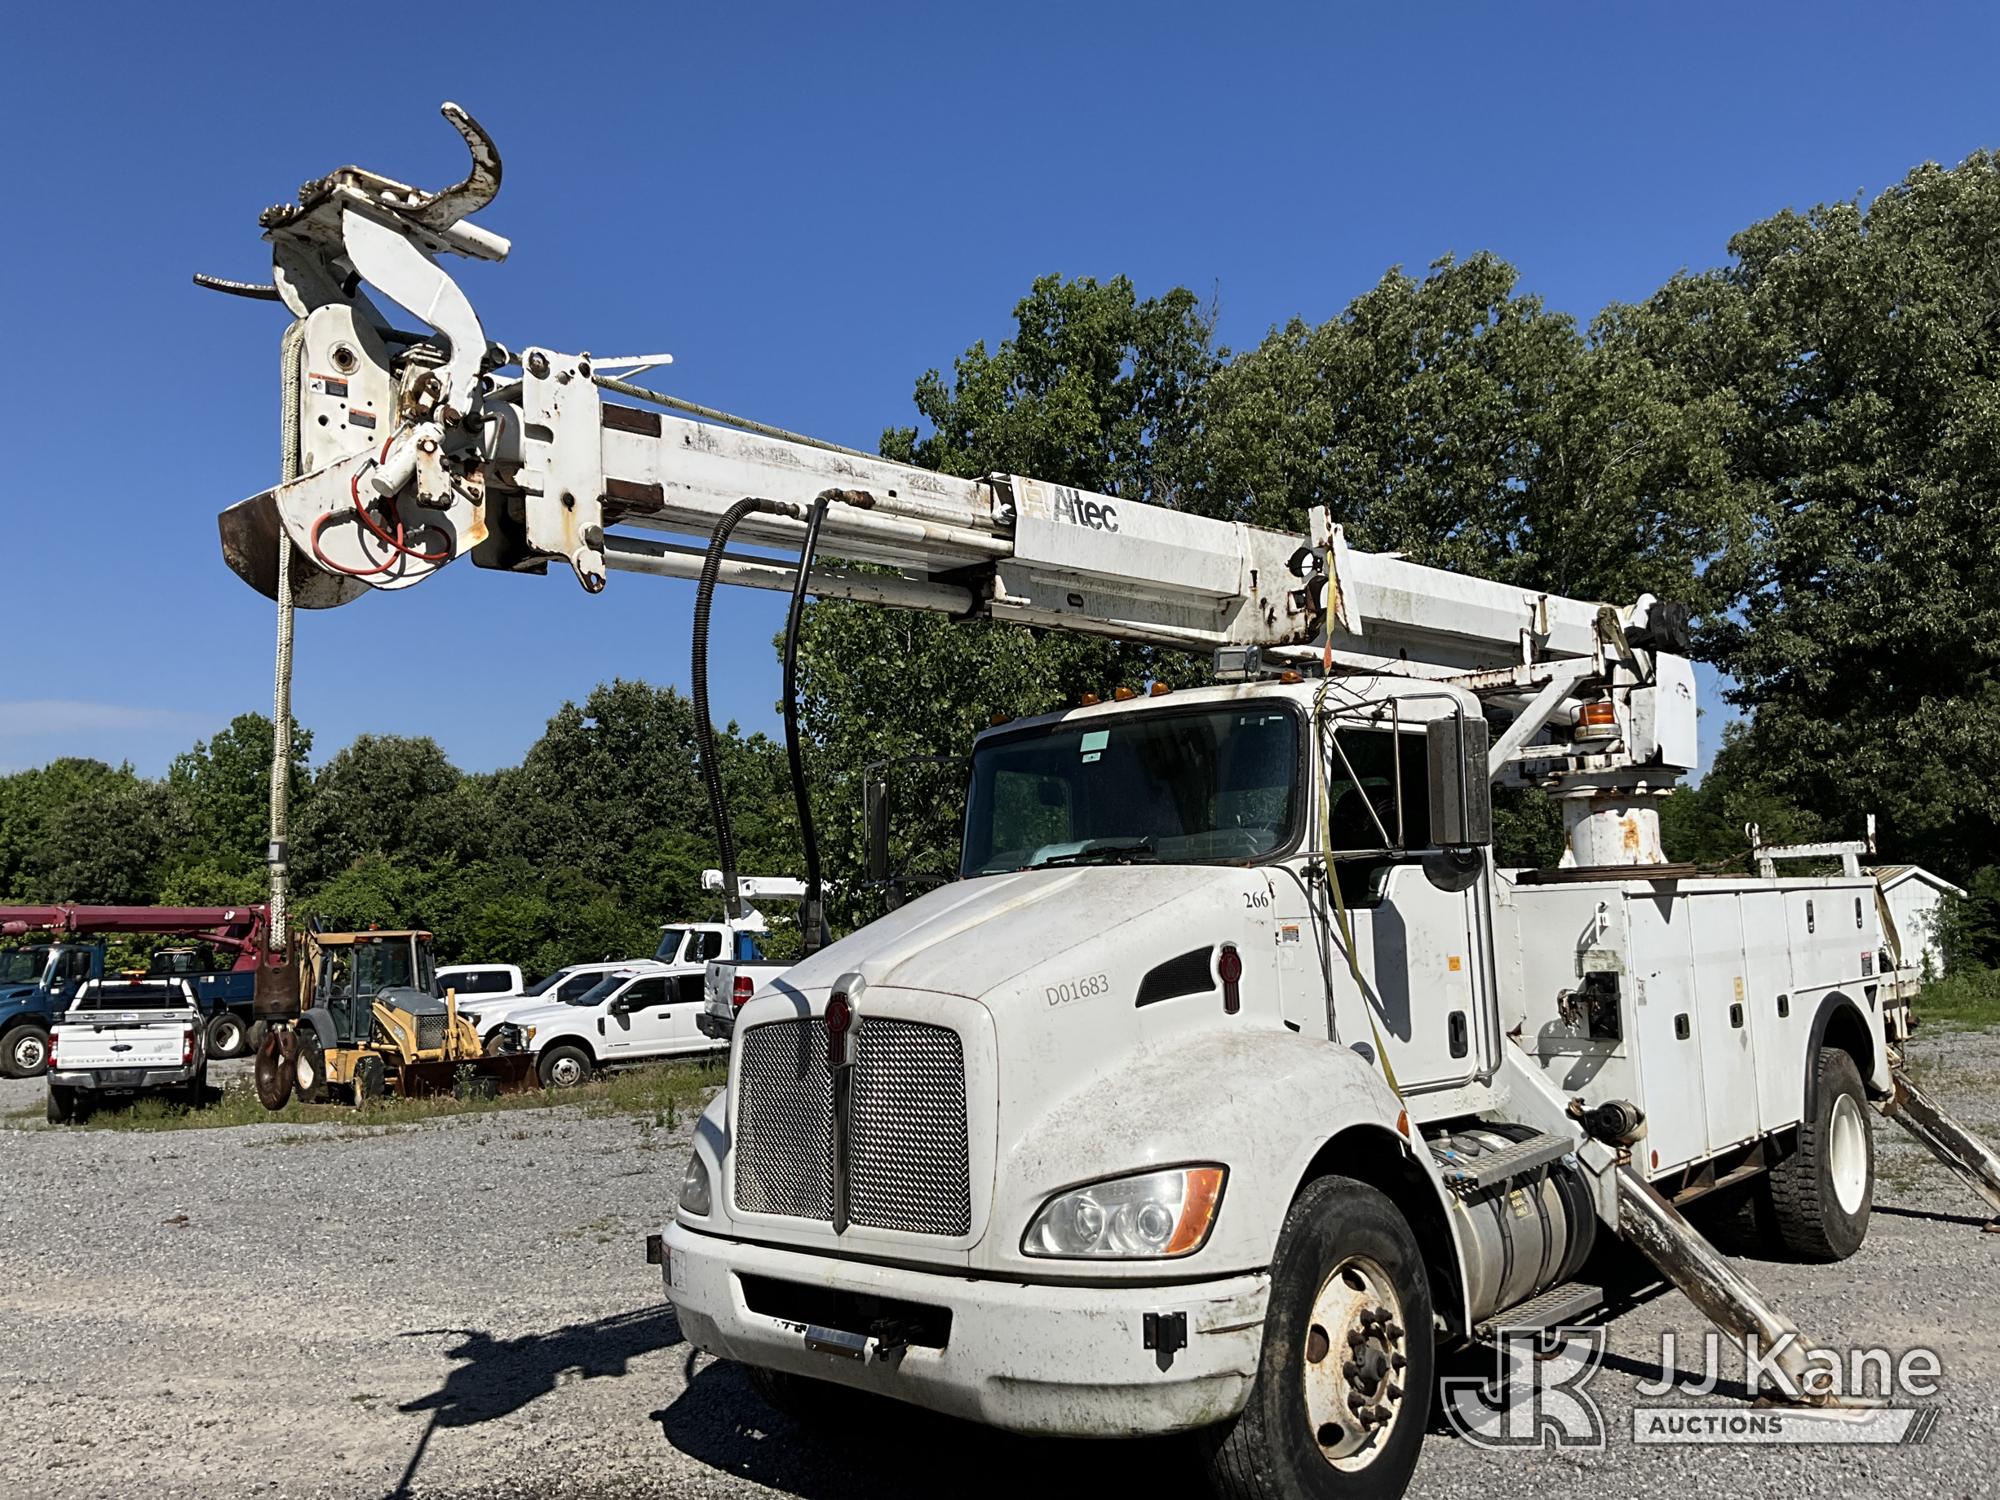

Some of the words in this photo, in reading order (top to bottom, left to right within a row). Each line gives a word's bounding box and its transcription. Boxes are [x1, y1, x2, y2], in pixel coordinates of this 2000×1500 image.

[1054, 486, 1118, 532] Altec
[1243, 891, 1269, 908] 266
[1046, 974, 1109, 1006] D01683
